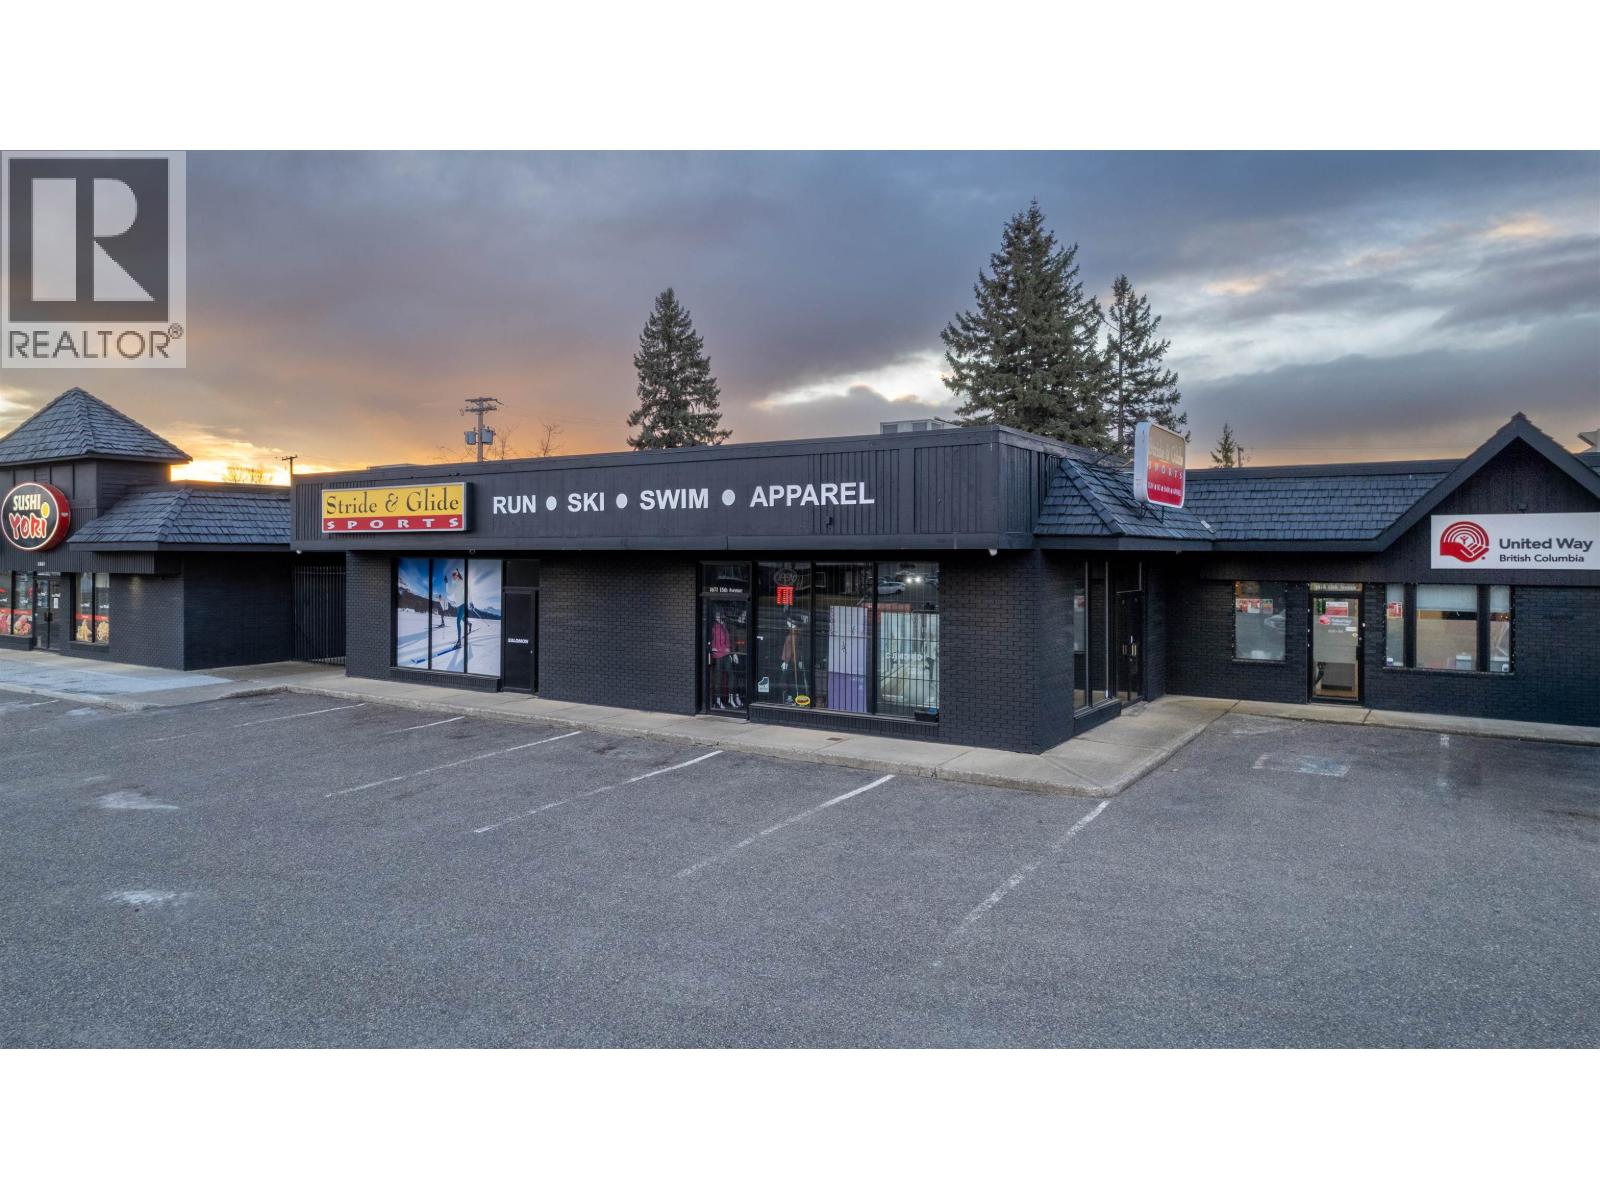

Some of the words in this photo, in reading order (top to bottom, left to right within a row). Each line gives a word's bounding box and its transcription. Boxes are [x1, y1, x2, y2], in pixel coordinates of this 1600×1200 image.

[13, 493, 42, 511] SUSHI
[326, 491, 378, 515] Stride
[385, 492, 399, 513] &
[406, 486, 459, 512] Glide
[492, 494, 537, 515] RUN
[567, 492, 605, 513] SKI
[639, 488, 709, 511] SWIM
[749, 481, 876, 508] APPAREL
[327, 517, 459, 530] SPORTS
[1499, 537, 1553, 550] United
[1556, 537, 1594, 553] Way
[1499, 554, 1531, 563] British
[1534, 554, 1585, 563] Columbia
